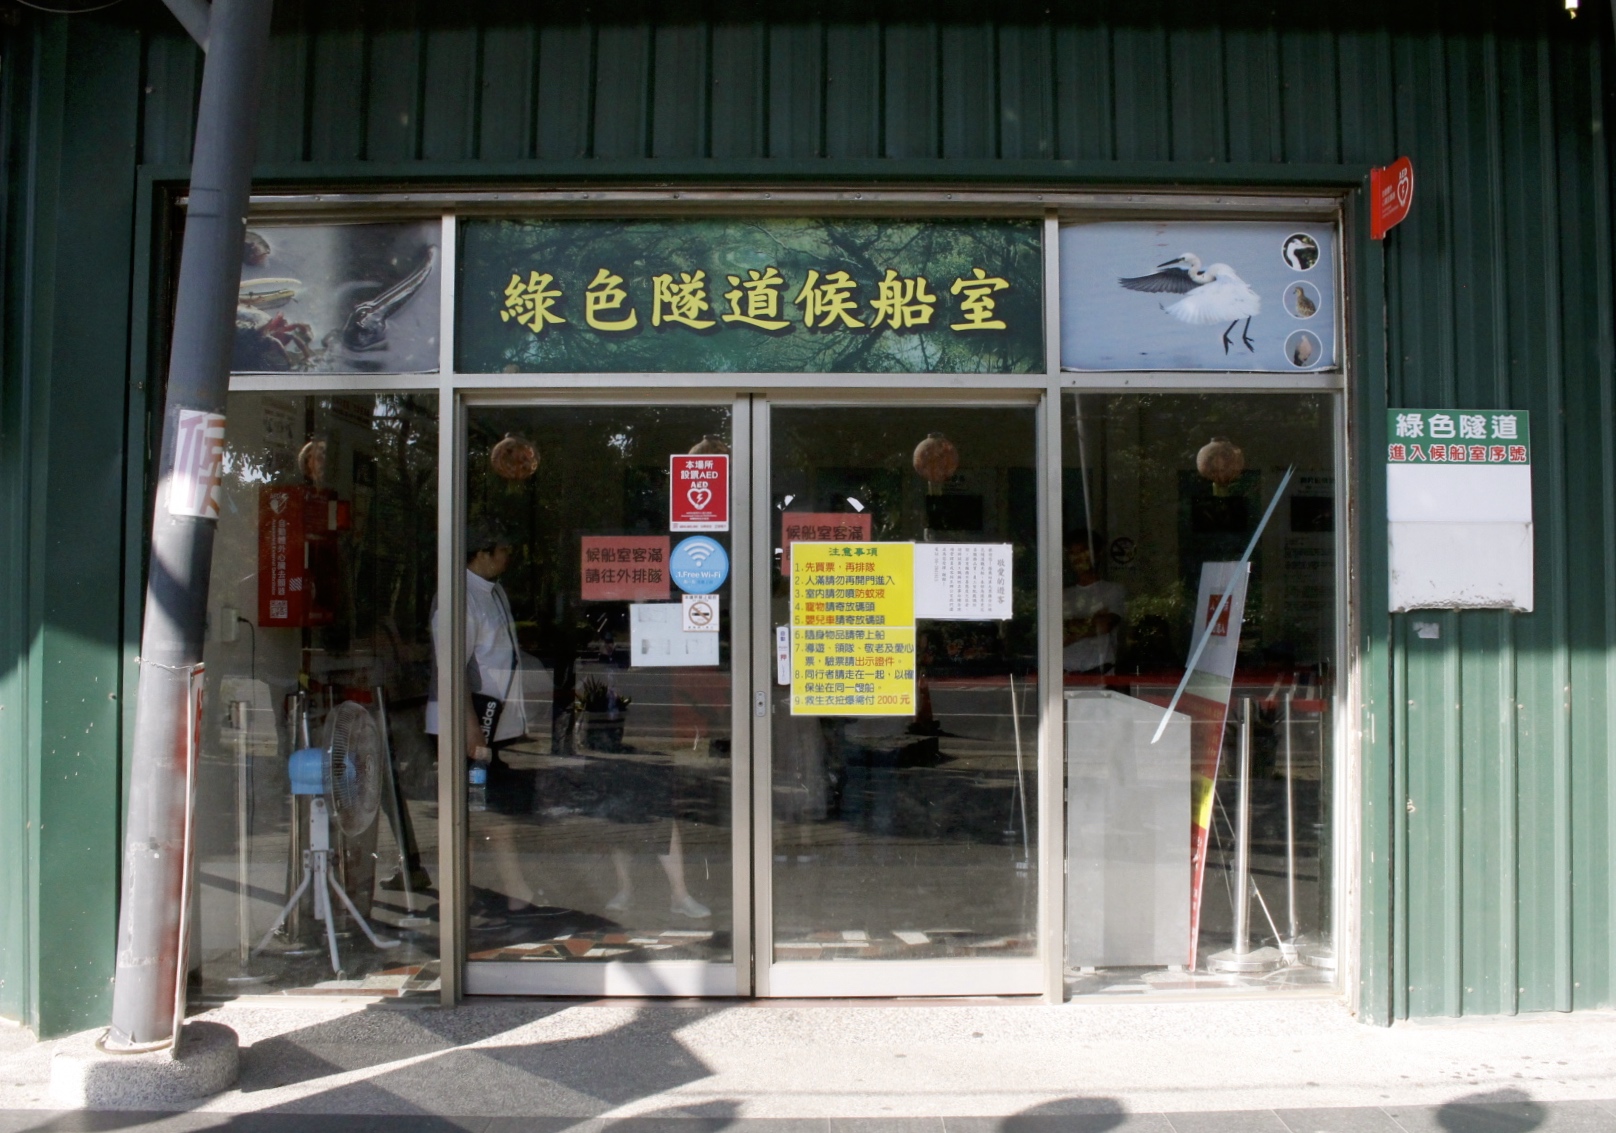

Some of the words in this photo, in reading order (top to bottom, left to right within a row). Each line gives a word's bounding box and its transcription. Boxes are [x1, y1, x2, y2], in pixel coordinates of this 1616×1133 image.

[500, 267, 1009, 332] 綠色隧道候船室
[1396, 413, 1518, 439] 綠色隧道
[1388, 444, 1527, 463] 進入候船室序號
[685, 460, 714, 470] 本場所
[680, 470, 719, 480] 設置AED
[786, 525, 863, 540] 候船室客滿
[586, 547, 663, 563] 候船室客滿
[828, 547, 879, 557] 注意事項
[585, 568, 663, 584] 請往外排隊
[877, 695, 898, 705] 2000
[900, 694, 911, 706] 元
[480, 701, 497, 744] didas
